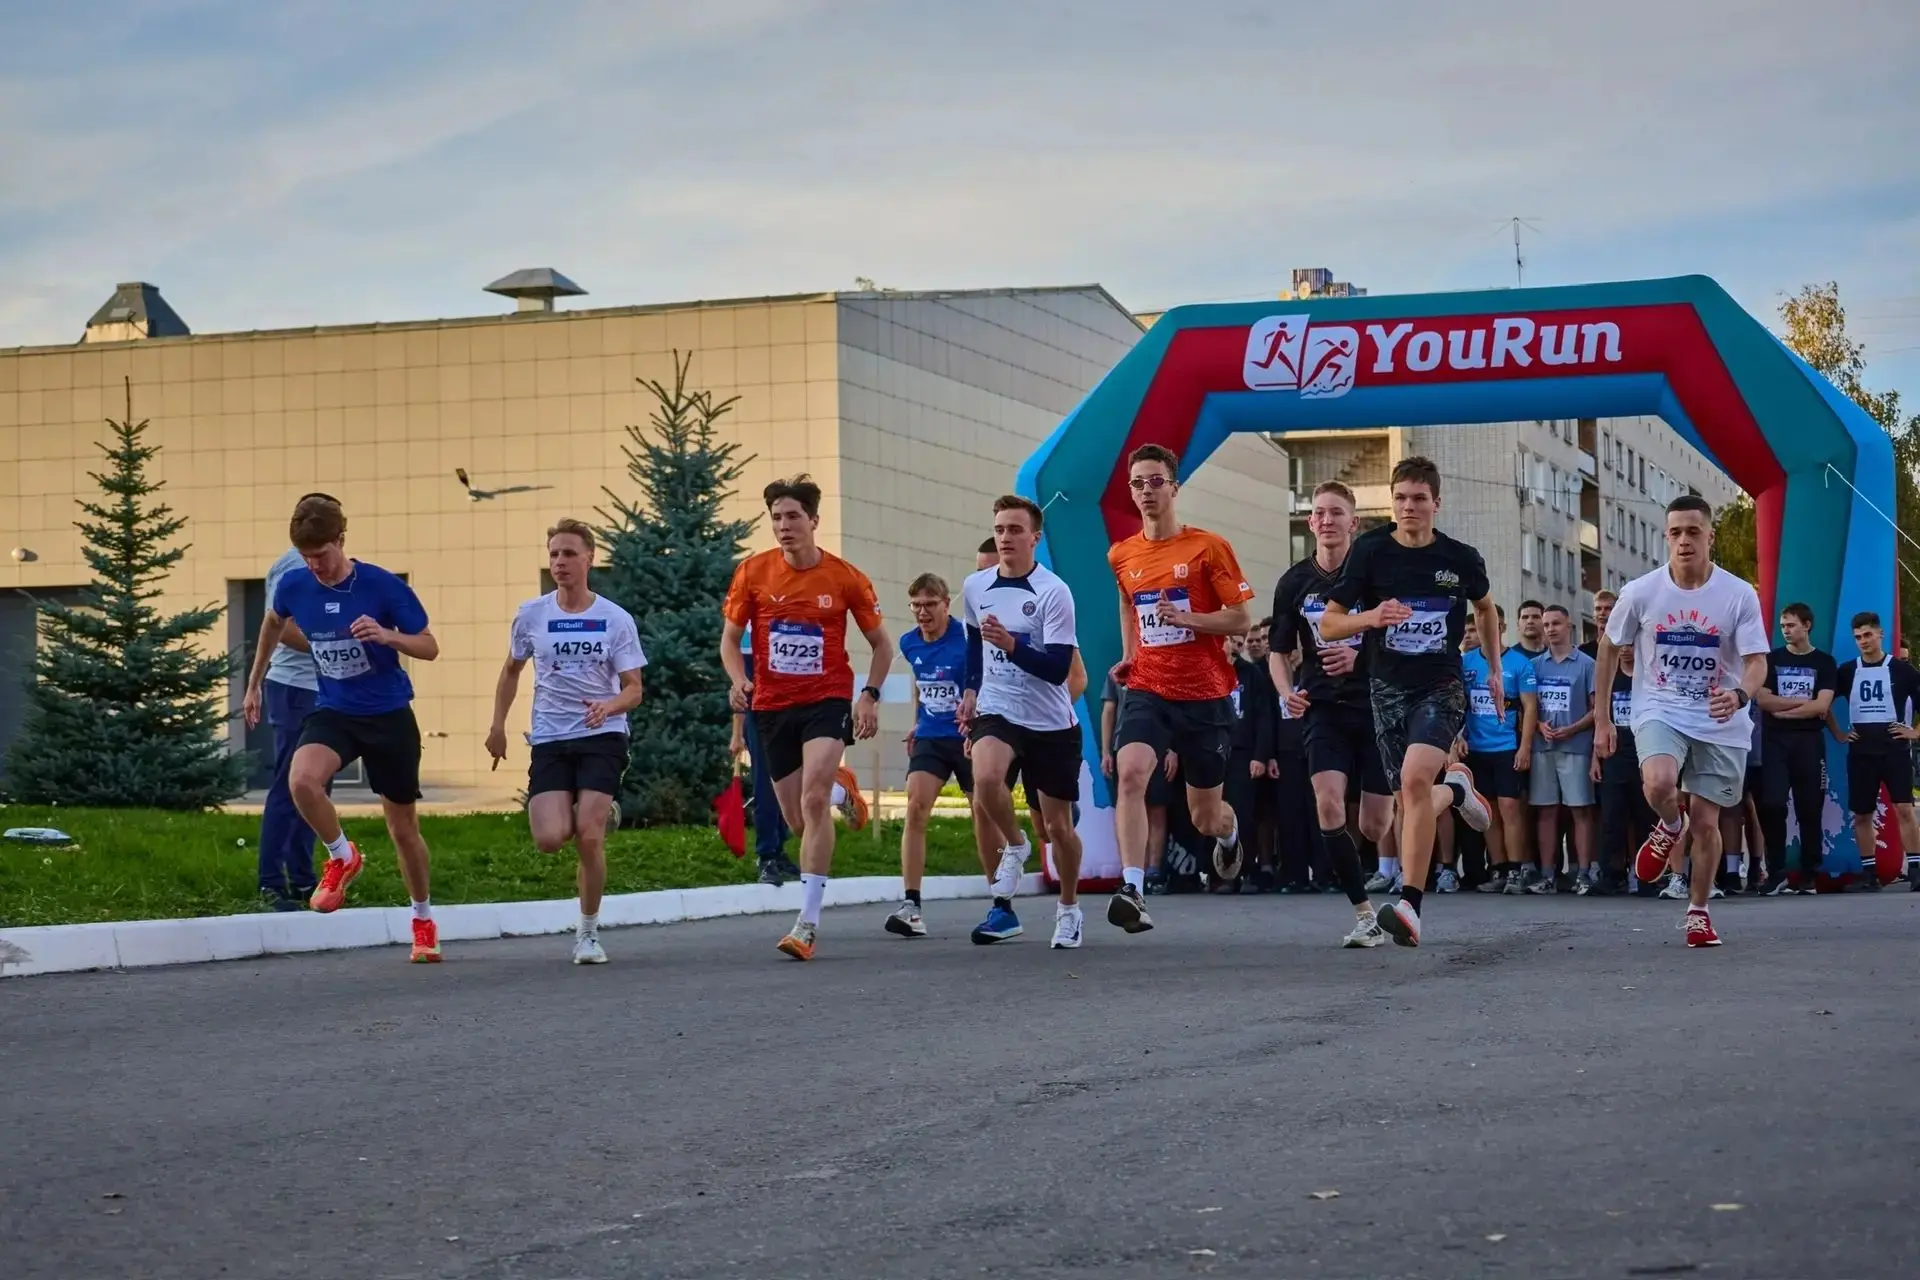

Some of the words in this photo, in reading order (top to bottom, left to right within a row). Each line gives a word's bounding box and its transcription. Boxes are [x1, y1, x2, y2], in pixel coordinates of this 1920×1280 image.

[1366, 317, 1622, 373] YouRun
[1173, 564, 1188, 578] 10
[817, 594, 832, 608] 10
[1394, 621, 1443, 635] 14782
[315, 646, 361, 662] 14750
[553, 641, 604, 656] 14794
[773, 642, 820, 658] 14723
[1660, 653, 1717, 671] 14709
[1781, 681, 1811, 691] 14751
[1860, 680, 1885, 702] 64
[1540, 691, 1568, 701] 14735
